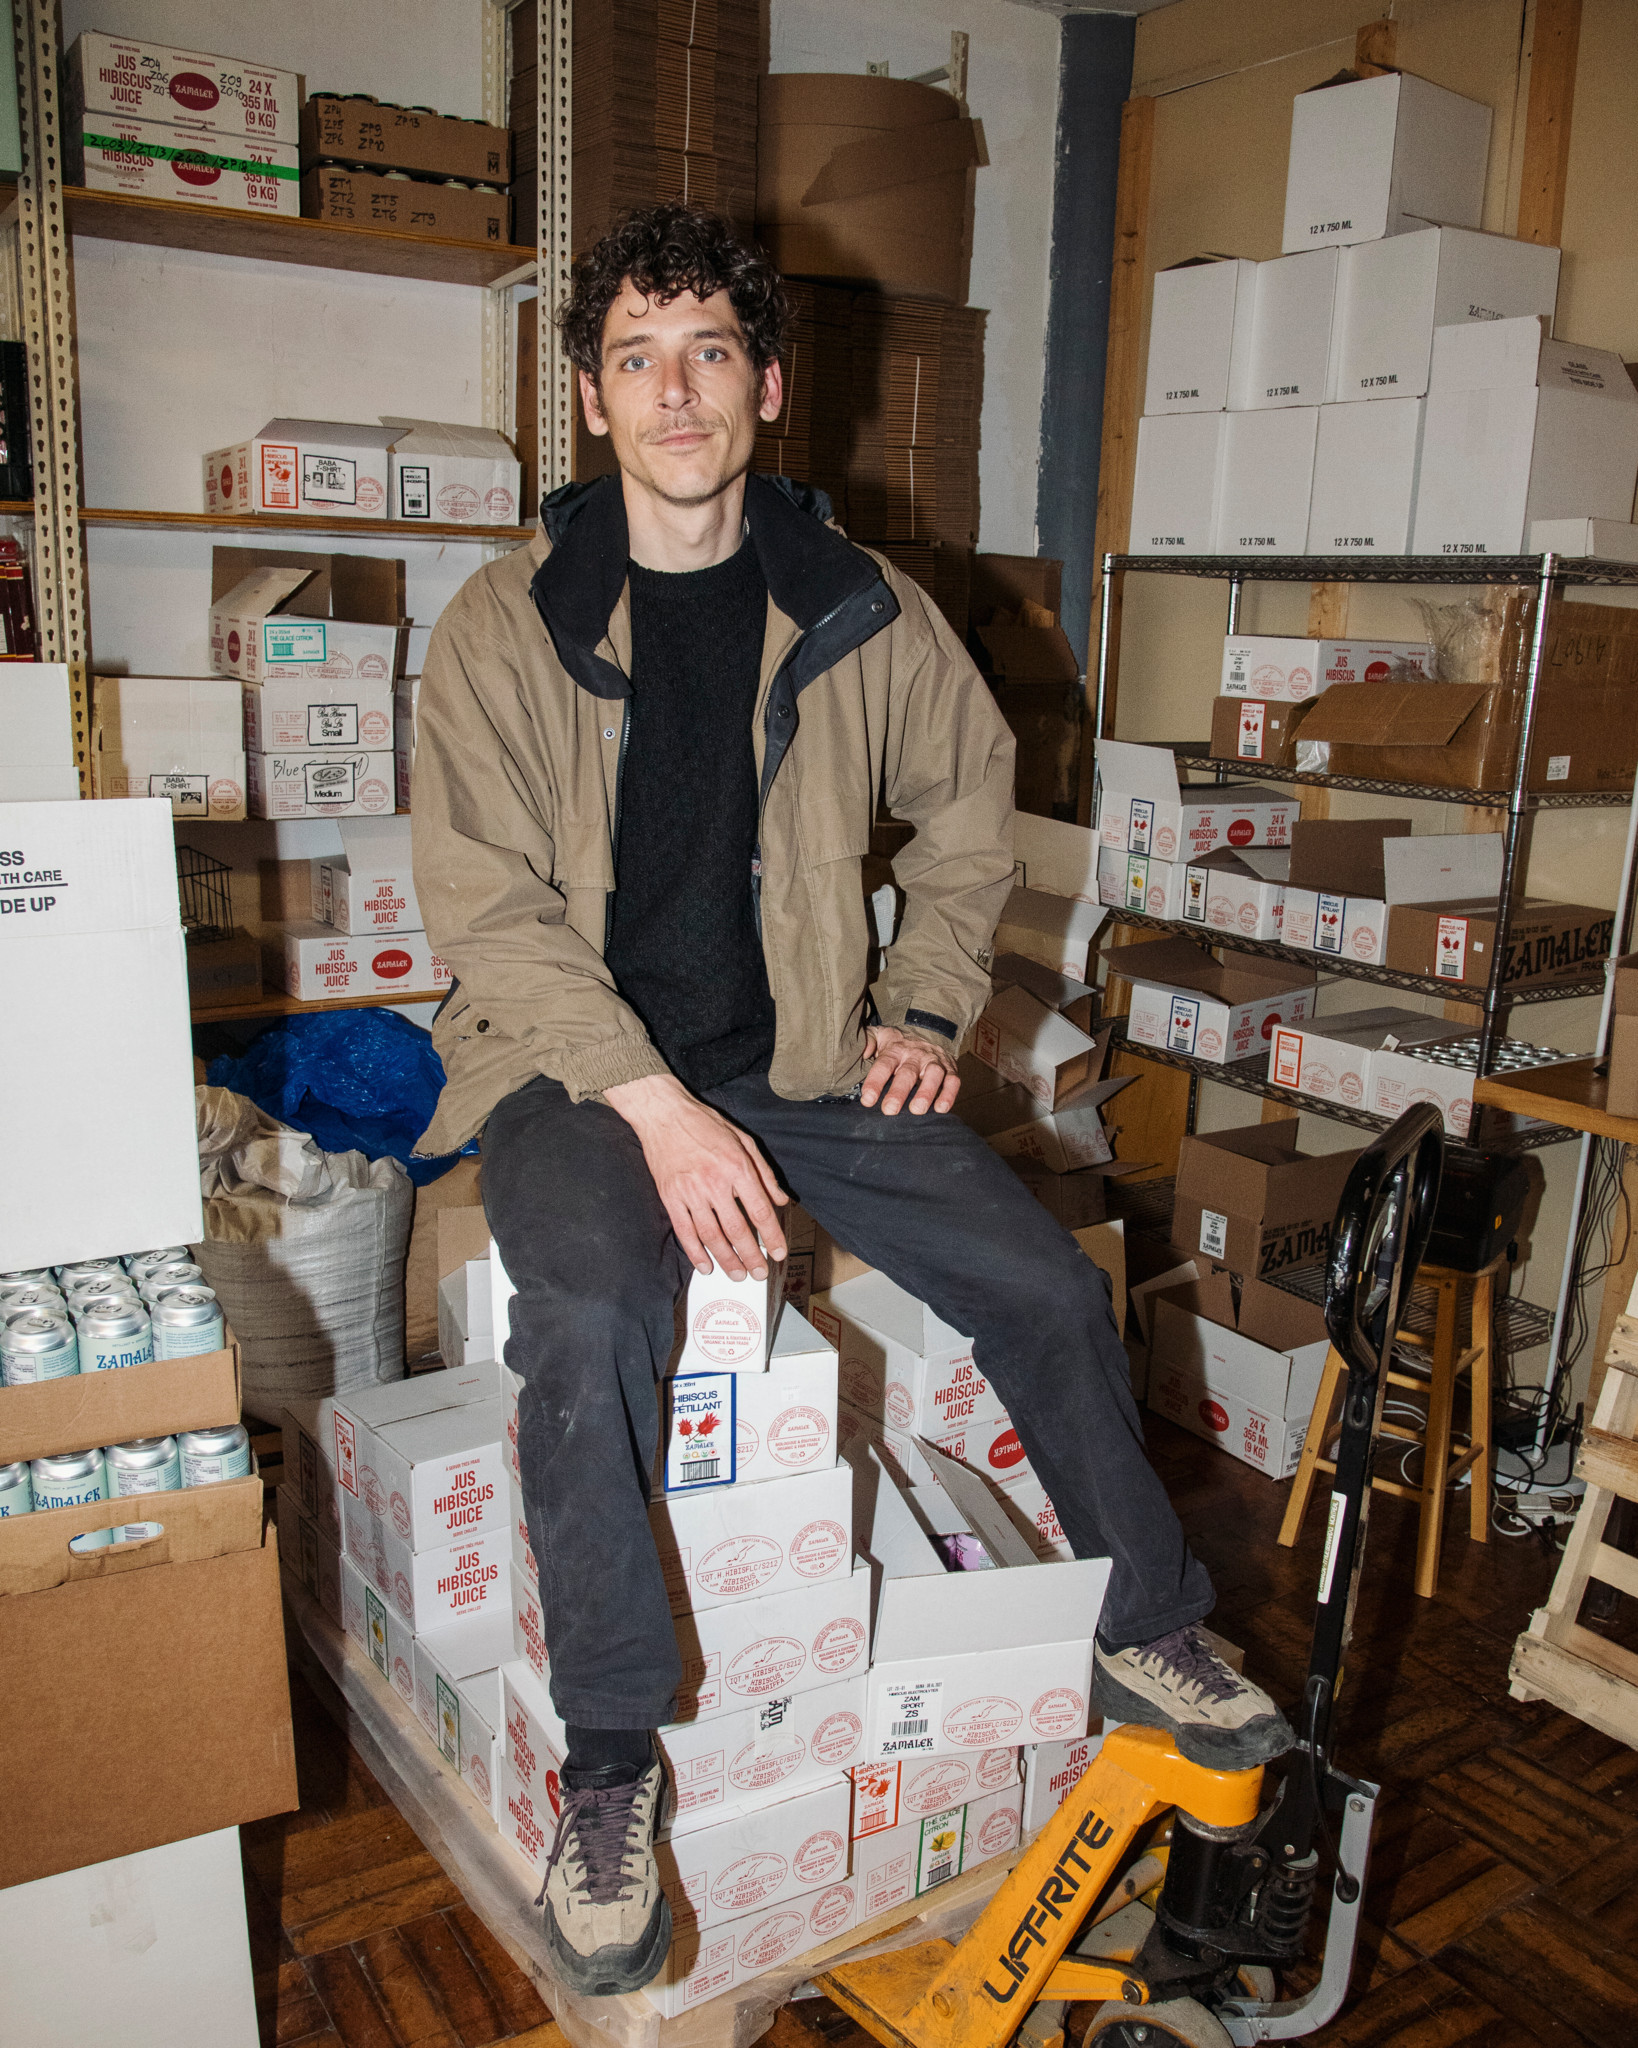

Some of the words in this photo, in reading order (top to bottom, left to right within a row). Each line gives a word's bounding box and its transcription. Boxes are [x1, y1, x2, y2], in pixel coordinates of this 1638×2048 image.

[114, 53, 136, 71] JUS
[99, 67, 152, 90] HIBISCUS
[110, 86, 142, 105] JUICE
[174, 84, 214, 99] ZAMALEK
[249, 79, 262, 95] 24
[264, 82, 272, 97] X
[242, 94, 261, 110] 355
[264, 98, 279, 113] ML
[245, 109, 256, 126] (9
[259, 112, 276, 129] KG)
[247, 185, 257, 199] (9
[261, 187, 278, 202] KG)
[1310, 225, 1318, 235] 12
[1320, 224, 1326, 234] X
[1327, 222, 1340, 232] 750
[1341, 220, 1352, 230] ML
[1361, 379, 1368, 388] 12
[1369, 378, 1375, 387] X
[1376, 376, 1387, 386] 750
[1388, 375, 1398, 384] ML
[1166, 392, 1173, 400] 12
[1173, 391, 1178, 399] X
[1180, 390, 1190, 399] 750
[1190, 389, 1199, 397] ML
[1266, 389, 1273, 397] 12
[1274, 388, 1279, 396] X
[1280, 387, 1290, 395] 750
[1291, 386, 1299, 394] ML
[315, 465, 342, 473] T-SHIRT
[1151, 537, 1158, 546] 12
[1159, 537, 1164, 545] X
[1165, 537, 1176, 546] 750
[1177, 537, 1185, 546] ML
[1239, 537, 1247, 546] 12
[1248, 537, 1253, 546] X
[1255, 537, 1266, 546] 750
[1267, 537, 1276, 546] ML
[1334, 537, 1343, 547] 12
[1344, 537, 1349, 547] X
[1350, 537, 1363, 547] 750
[1364, 537, 1374, 547] ML
[1442, 543, 1452, 553] 12
[1453, 543, 1458, 553] X
[1460, 543, 1474, 553] 750
[1475, 543, 1486, 553] ML
[1335, 655, 1348, 668] JUS
[1325, 668, 1355, 681] HIBISCUS
[321, 729, 343, 737] Small
[273, 759, 300, 780] Blue
[314, 790, 342, 798] Medium
[1198, 816, 1211, 827] JUS
[1271, 815, 1279, 825] 24
[1280, 814, 1286, 824] X
[1188, 829, 1218, 840] HIBISCUS
[1266, 826, 1277, 837] 355
[1278, 826, 1287, 836] ML
[1193, 840, 1211, 852] JUICE
[23, 869, 62, 883] CARE
[375, 885, 394, 898] JUS
[30, 896, 57, 912] UP
[364, 897, 406, 912] HIBISCUS
[372, 911, 398, 924] JUICE
[327, 949, 345, 961] JUS
[1501, 918, 1615, 983] ZAMALEK
[315, 961, 358, 976] HIBISCUS
[376, 959, 409, 969] ZAMALEK
[323, 974, 350, 988] JUICE
[1240, 1016, 1250, 1027] JUS
[1233, 1027, 1255, 1041] HIBISCUS
[1235, 1040, 1250, 1052] JUICE
[951, 1364, 973, 1384] JUS
[673, 1390, 718, 1404] HIBISCUS
[934, 1378, 986, 1406] HIBISCUS
[673, 1400, 722, 1414] PÉTILLANT
[943, 1398, 975, 1421] JUICE
[1249, 1417, 1259, 1431] 24
[1260, 1422, 1266, 1434] X
[1243, 1427, 1257, 1443] 355
[1258, 1434, 1269, 1449] ML
[1244, 1441, 1252, 1453] (9
[1253, 1445, 1266, 1462] KG)
[451, 1470, 476, 1491] JUS
[34, 1487, 101, 1511] ZAMALEK
[433, 1484, 494, 1515] HIBISCUS
[446, 1505, 483, 1530] JUICE
[454, 1551, 480, 1572] JUS
[437, 1564, 498, 1595] HIBISCUS
[719, 1578, 760, 1593] SABDARIFFA
[723, 1572, 757, 1585] HIBISCUS
[449, 1585, 488, 1609] JUICE
[526, 1602, 539, 1630] JUS
[518, 1610, 548, 1661] HIBISCUS
[525, 1639, 544, 1674] JUICE
[746, 1678, 785, 1694] SABDARIFFA
[750, 1673, 782, 1686] HIBISCUS
[900, 1701, 925, 1709] SPORT
[904, 1709, 919, 1718] ZS
[515, 1711, 527, 1739] JUS
[962, 1734, 1001, 1744] SABDARIFFA
[966, 1728, 998, 1738] HIBISCUS
[507, 1717, 536, 1771] HIBISCUS
[882, 1737, 934, 1752] ZAMALEK
[1066, 1744, 1088, 1767] JUS
[513, 1747, 532, 1784] JUICE
[855, 1765, 897, 1784] GINGEMBRE
[518, 1790, 534, 1818] JUS
[508, 1795, 545, 1848] HIBISCUS
[924, 1820, 949, 1836] CITRON
[925, 1818, 938, 1828] THÉ
[515, 1823, 538, 1859] JUICE
[983, 1810, 1114, 2003] LIFT-RITE
